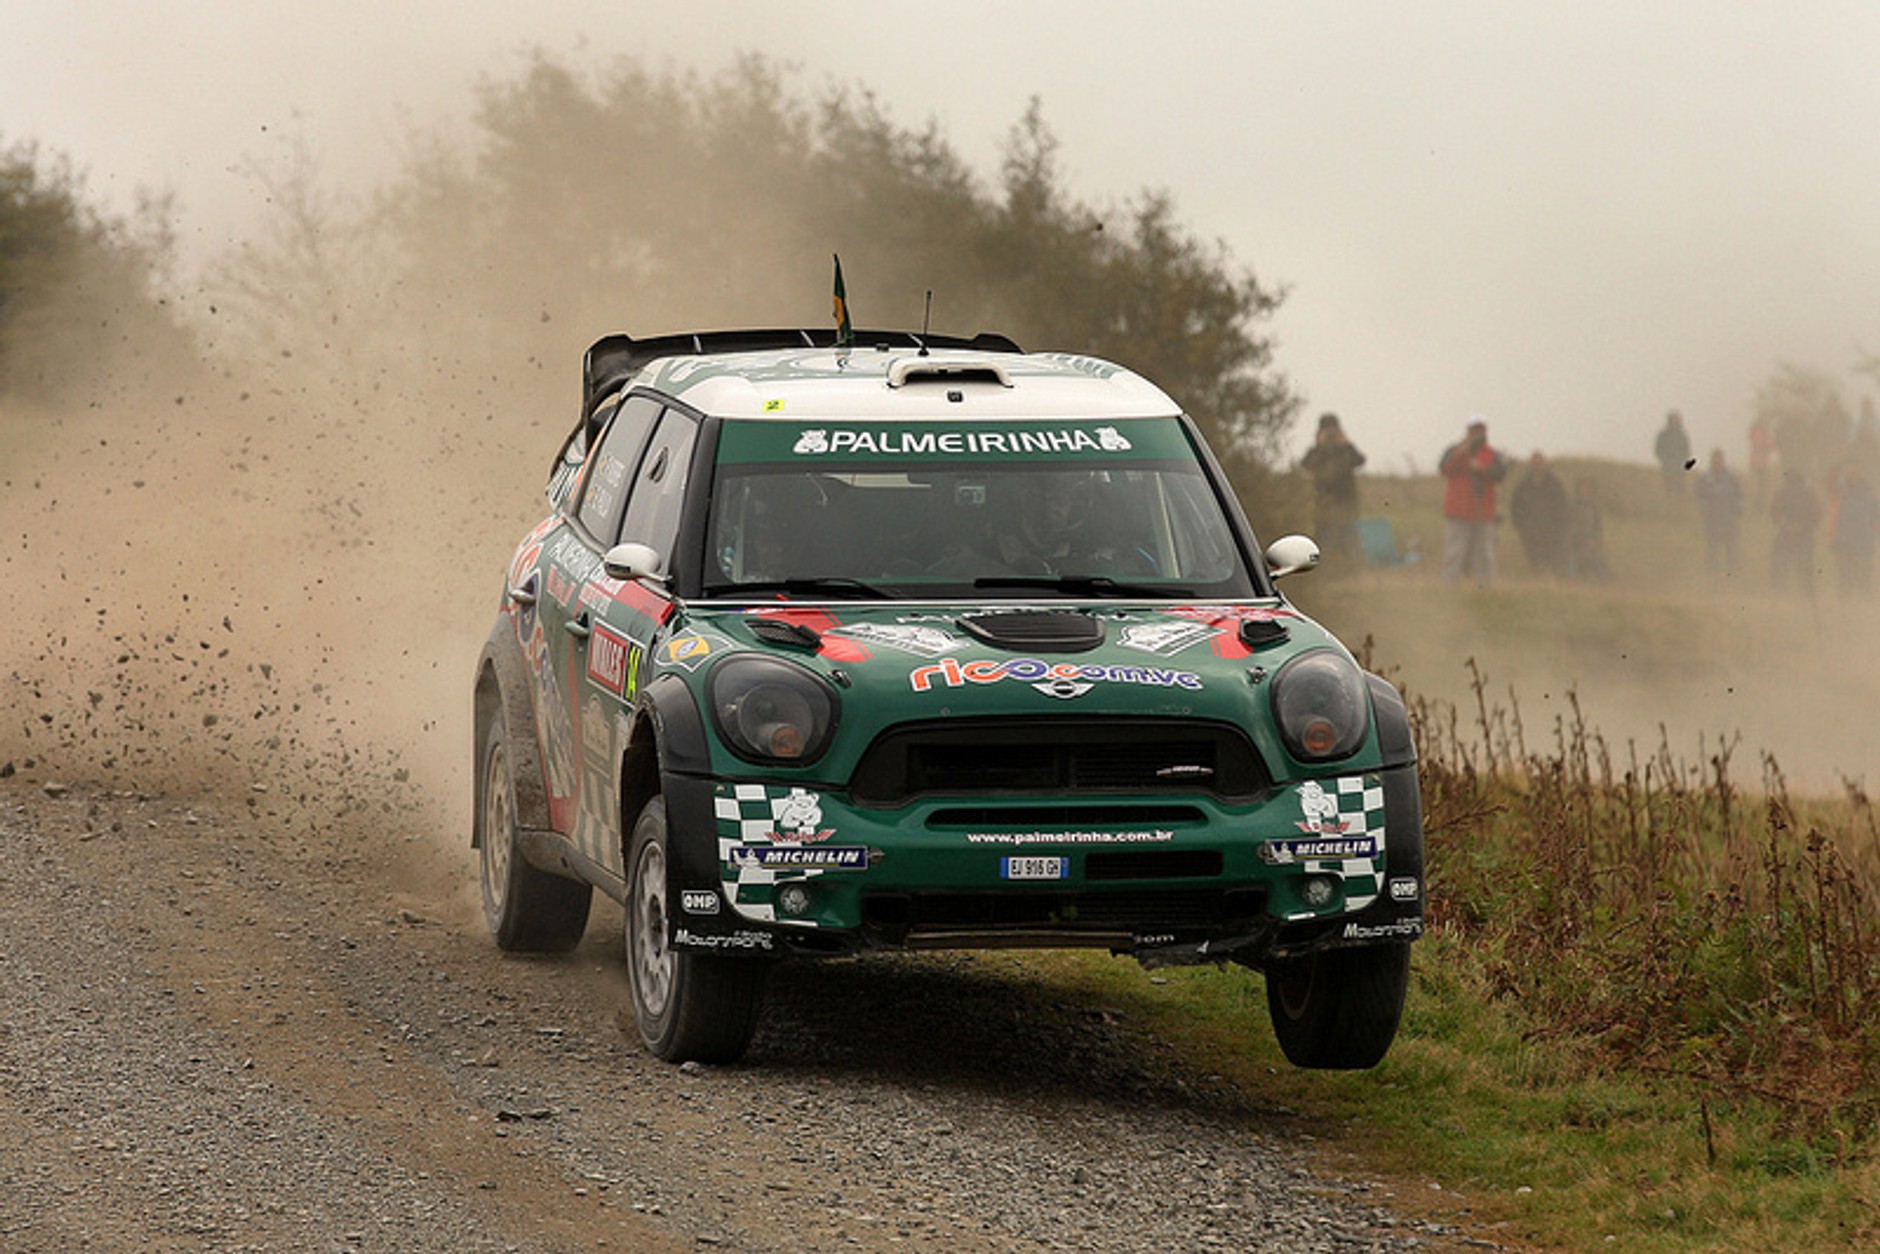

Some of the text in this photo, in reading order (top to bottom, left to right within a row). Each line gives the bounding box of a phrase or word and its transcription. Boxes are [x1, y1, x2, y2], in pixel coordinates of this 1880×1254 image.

[829, 429, 1101, 454] PALMEIRINHA
[966, 830, 1173, 845] www.palmeirinha.com.br
[1295, 840, 1373, 855] MICHELIN
[764, 849, 861, 864] MICHELIN
[683, 894, 716, 908] OMP
